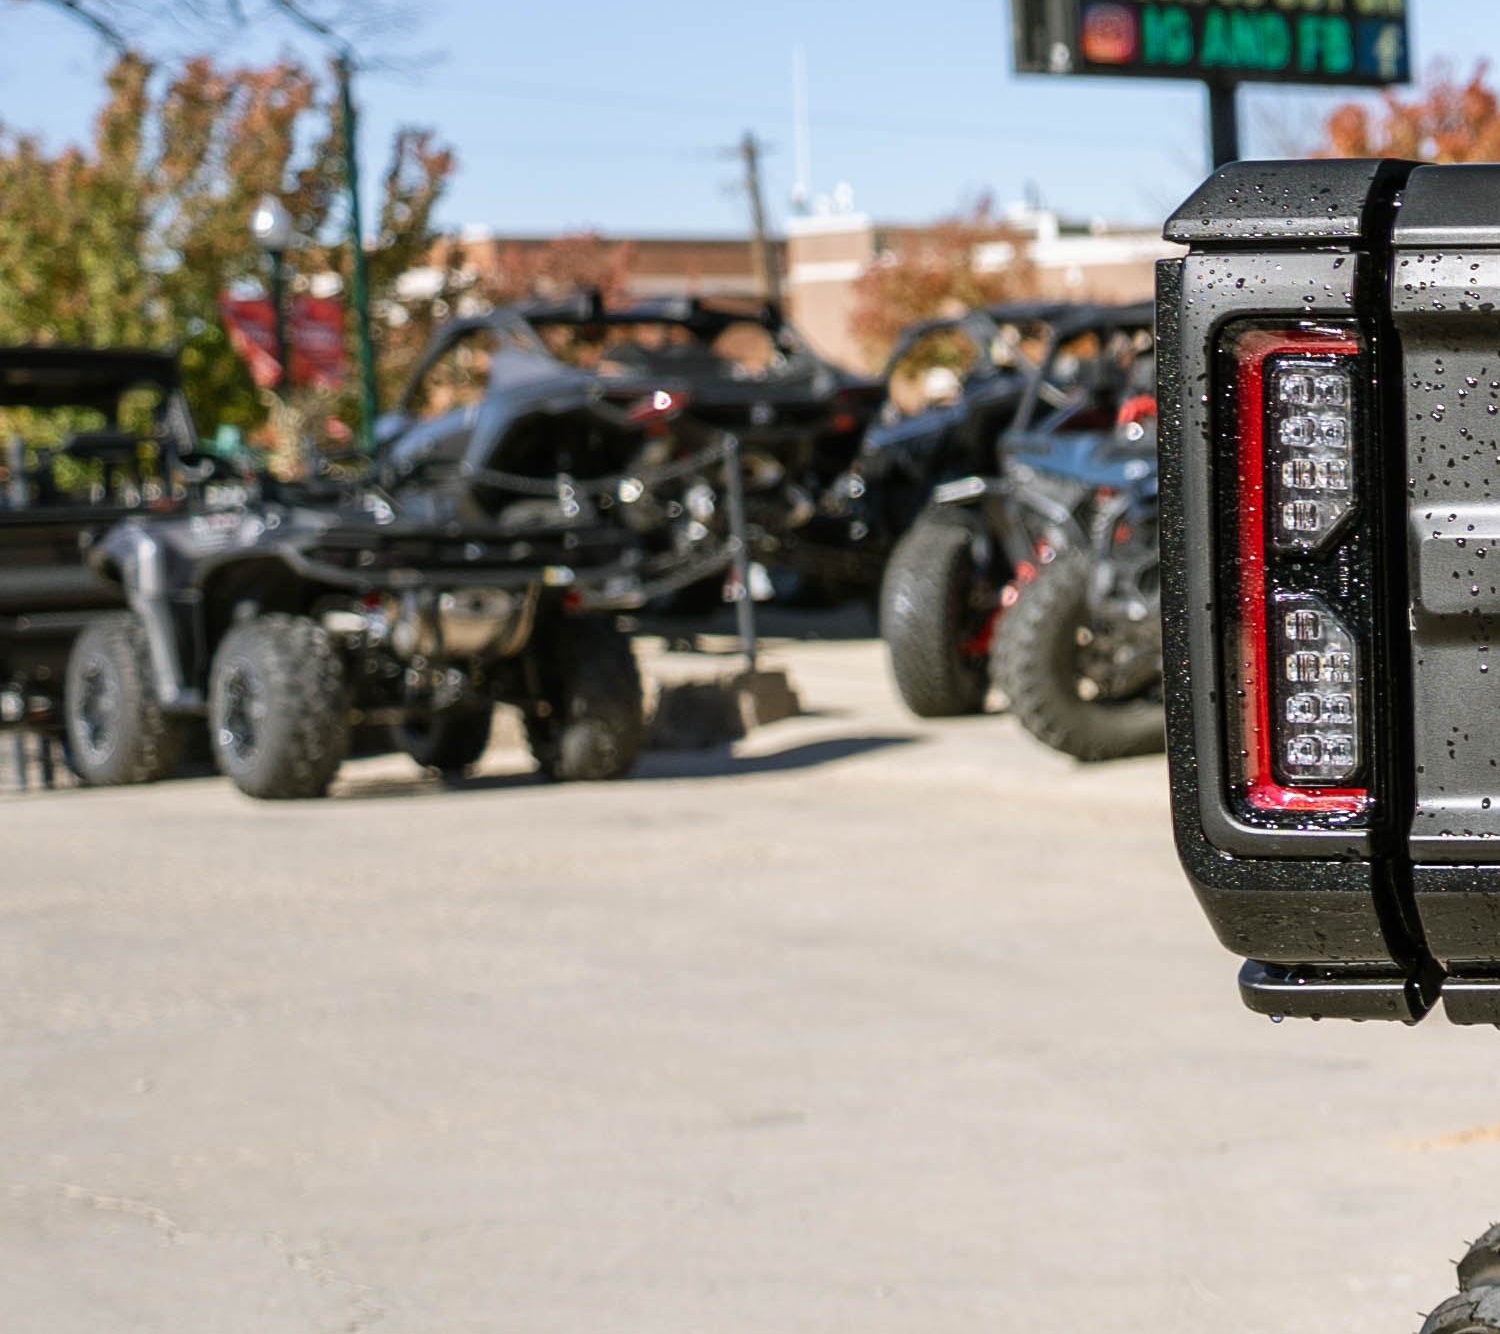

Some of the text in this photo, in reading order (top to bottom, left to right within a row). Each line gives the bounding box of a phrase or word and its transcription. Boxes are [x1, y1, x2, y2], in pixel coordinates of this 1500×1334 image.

[1141, 3, 1194, 65] IG
[1200, 5, 1293, 70] AND
[1296, 11, 1355, 74] FB
